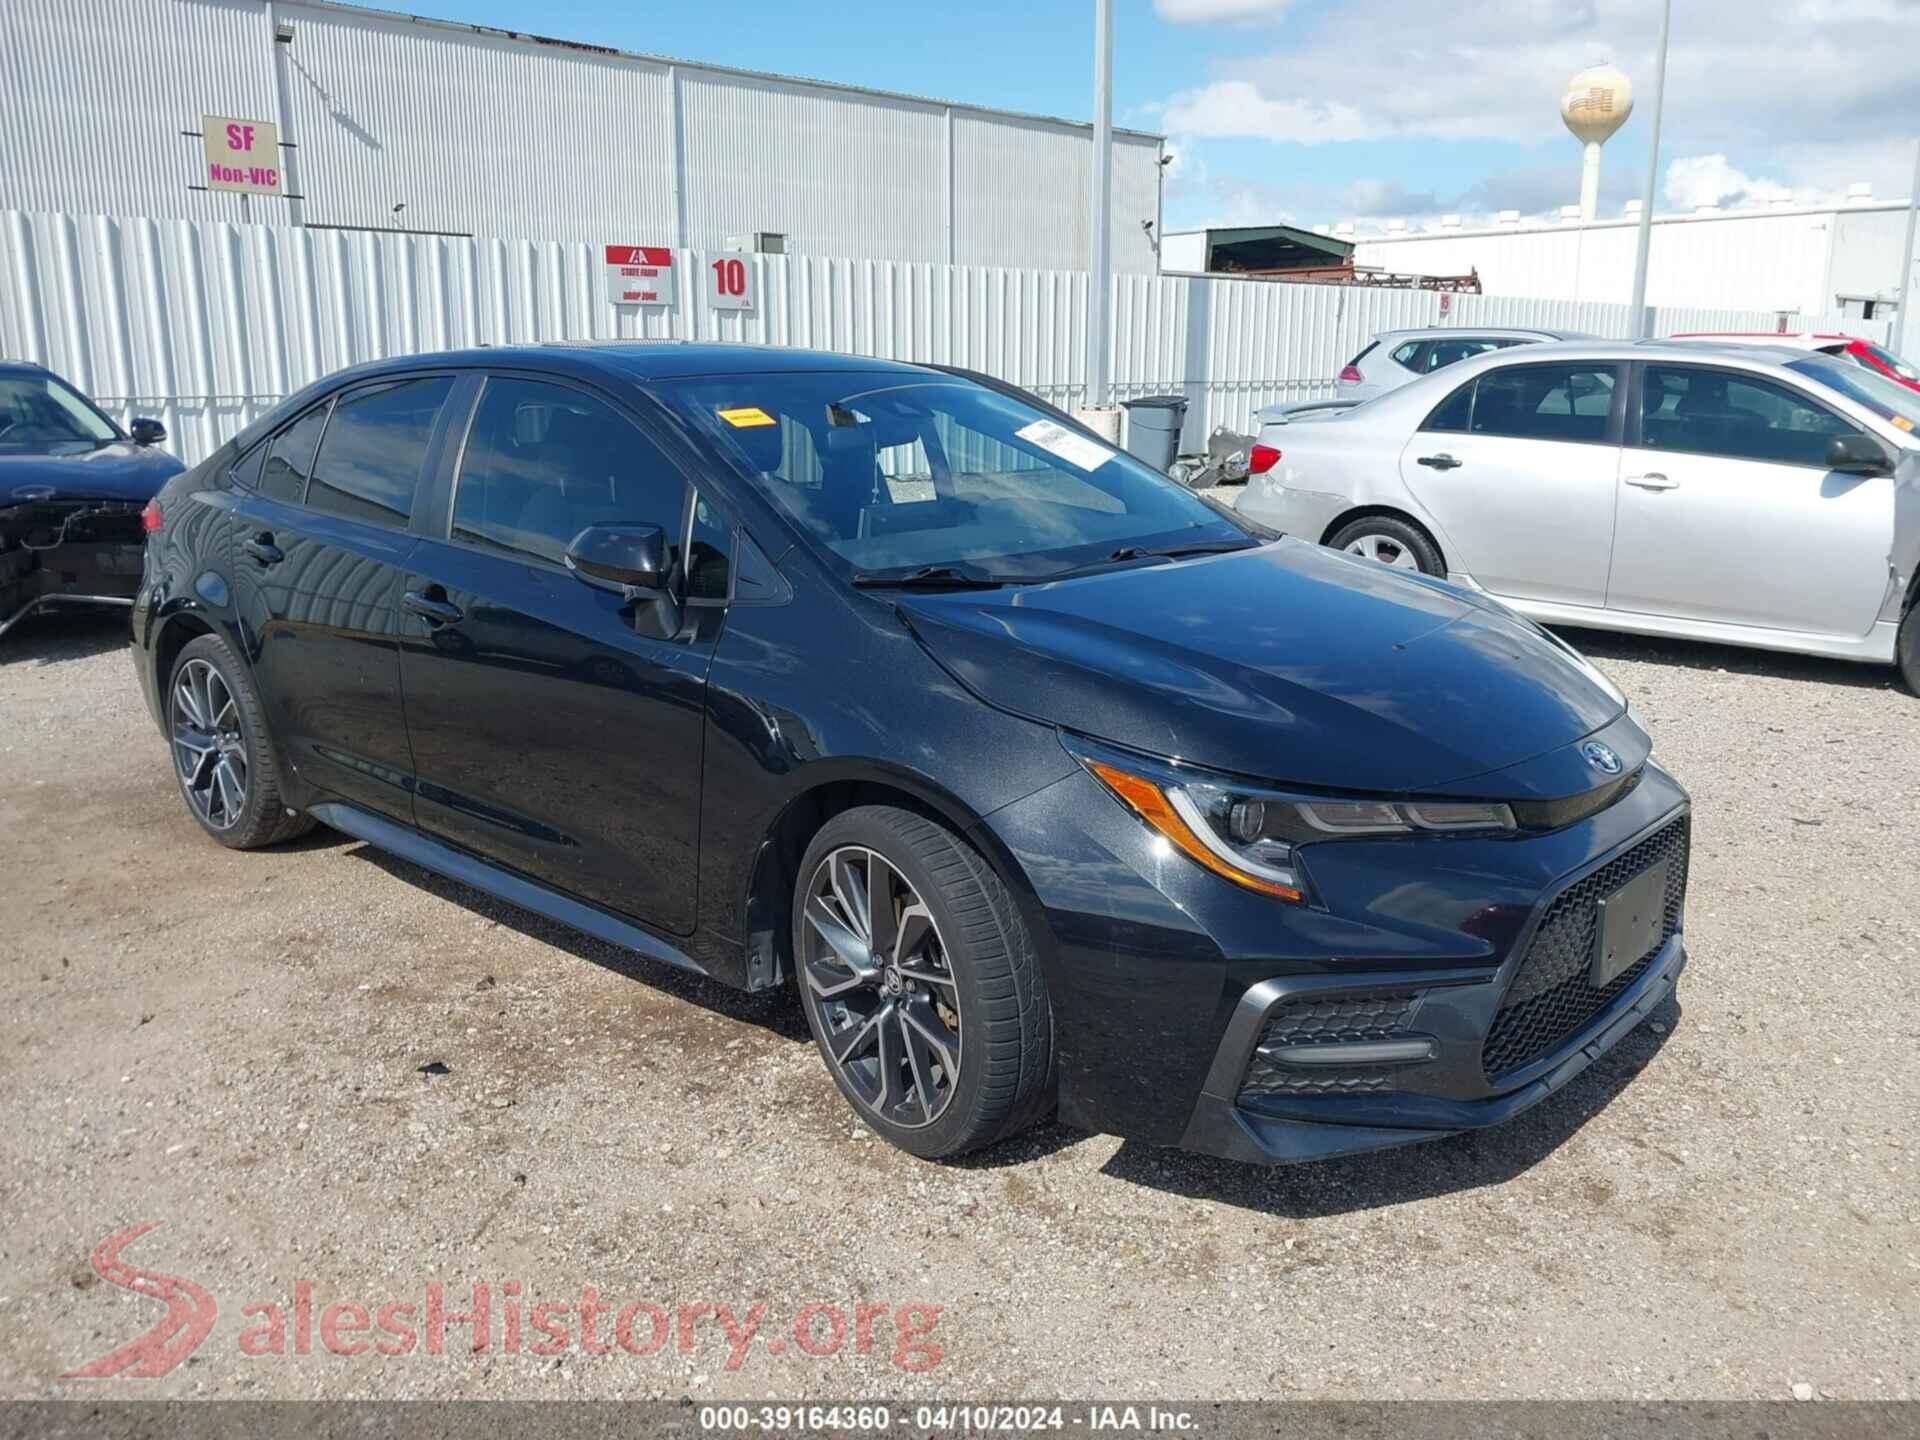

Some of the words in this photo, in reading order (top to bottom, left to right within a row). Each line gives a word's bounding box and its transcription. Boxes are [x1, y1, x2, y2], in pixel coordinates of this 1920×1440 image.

[226, 123, 254, 151] SF
[210, 163, 277, 186] Non-VIC
[712, 258, 745, 296] 10
